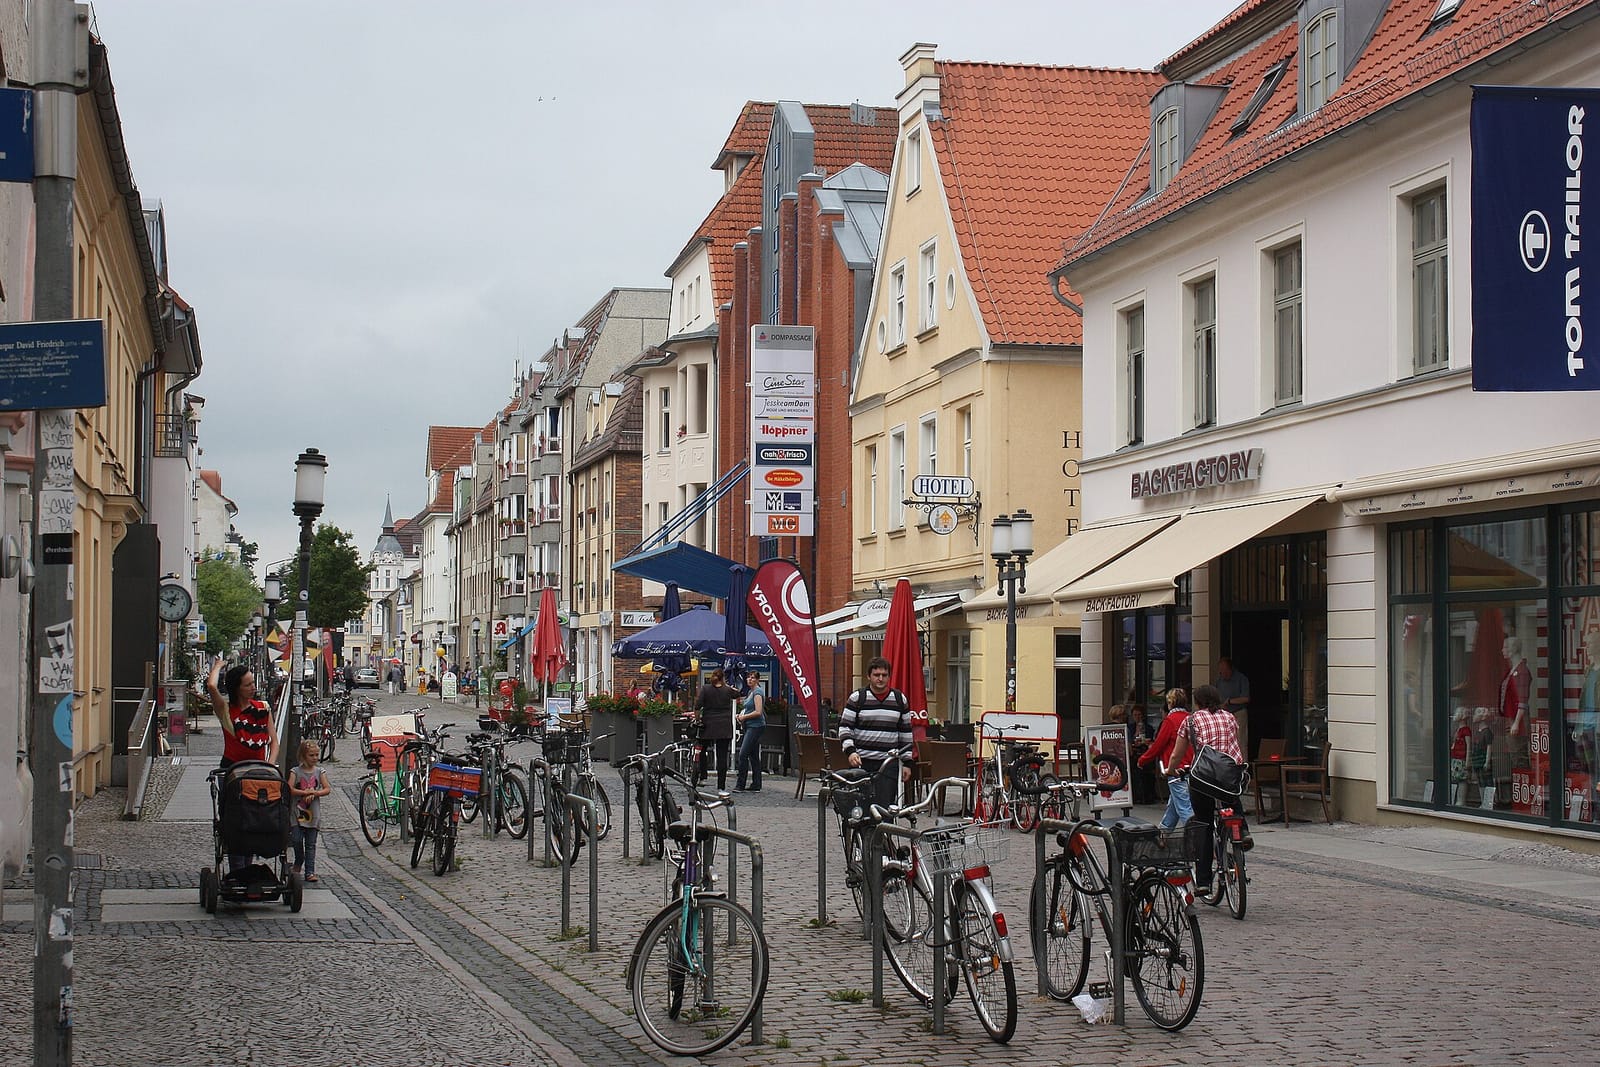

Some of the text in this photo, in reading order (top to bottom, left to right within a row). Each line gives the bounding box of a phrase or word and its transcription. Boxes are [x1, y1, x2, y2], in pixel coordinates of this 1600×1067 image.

[1565, 105, 1585, 377] TOM TAILOR
[16, 341, 34, 349] David
[36, 340, 64, 348] Friedrich
[919, 478, 969, 495] HOTEL
[1512, 782, 1544, 806] 50%
